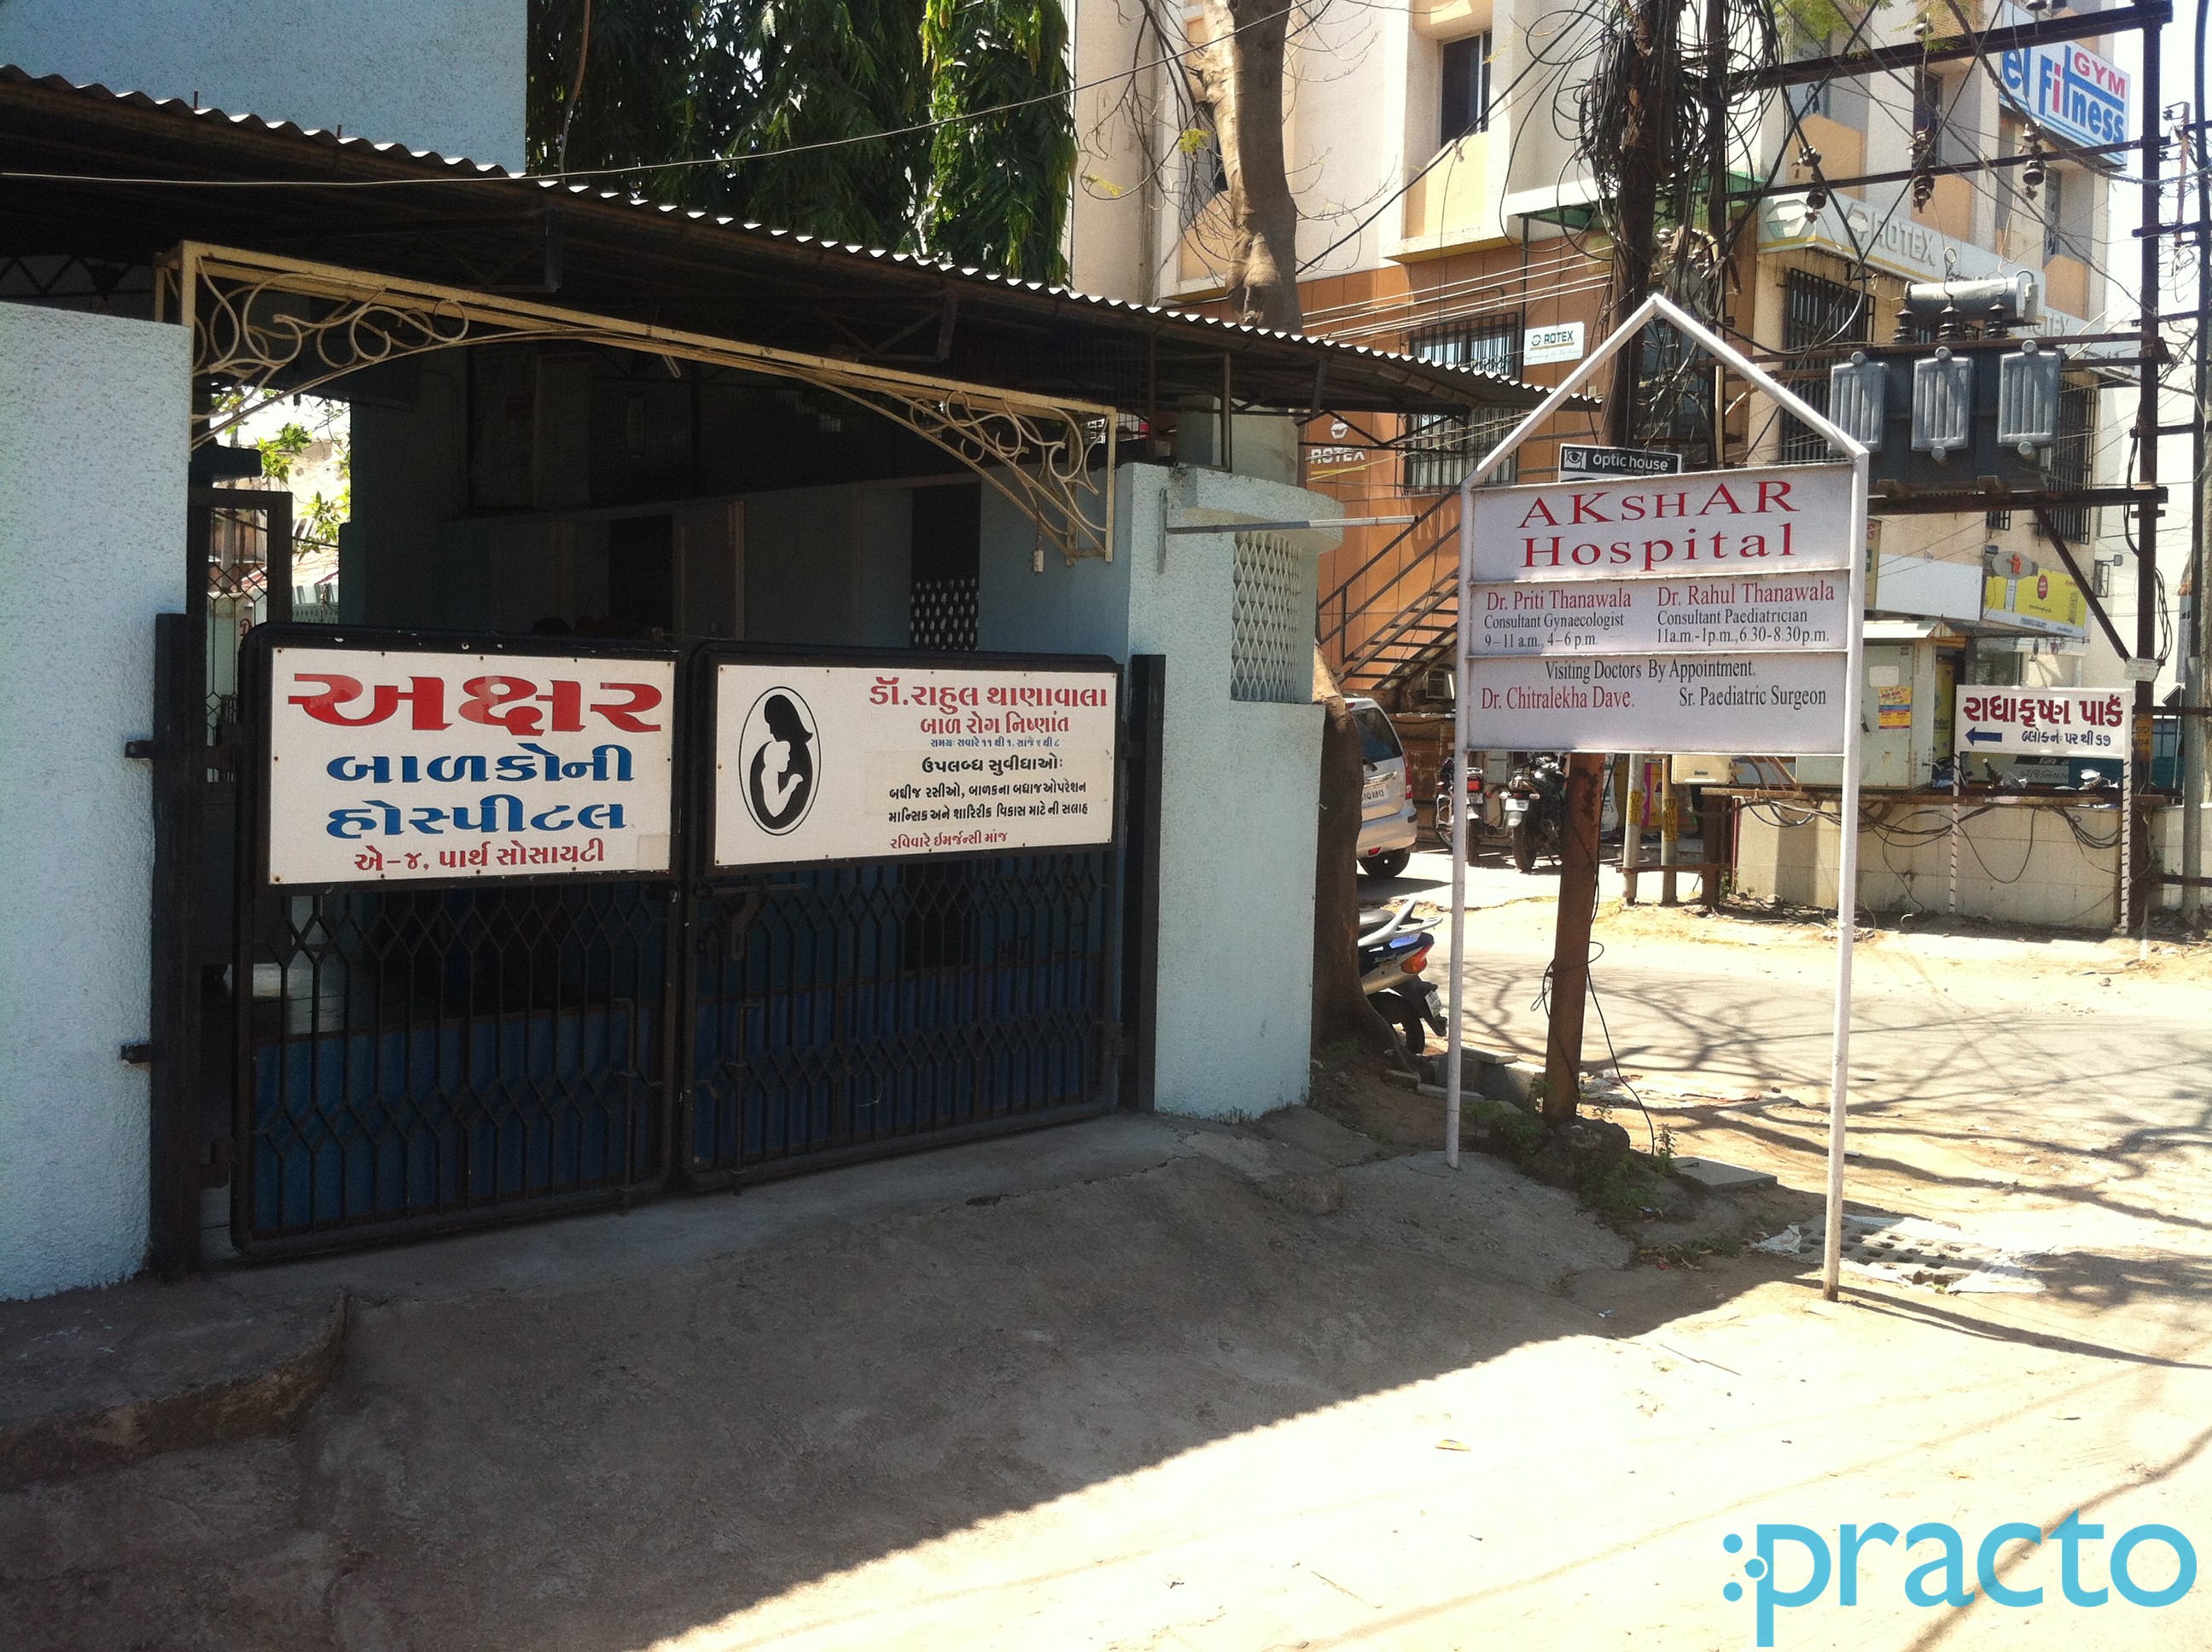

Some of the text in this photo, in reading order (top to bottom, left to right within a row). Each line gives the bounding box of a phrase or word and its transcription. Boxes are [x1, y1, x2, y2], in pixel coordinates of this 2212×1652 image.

[2074, 52, 2125, 99] GYM
[2039, 44, 2124, 143] Fitness
[1544, 330, 1574, 345] ROTEX
[1592, 452, 1626, 468] optic
[1629, 456, 1668, 470] house
[1516, 480, 1801, 529] AKSHAR
[1520, 522, 1796, 572] Hospital
[1487, 588, 1631, 610] Dr. Priti Thanawala
[1657, 579, 1835, 607] Dr. Rahul Thanawala
[1484, 611, 1624, 631] Consultant Gynaecologist
[1657, 607, 1807, 625] Consultant Paediatrician
[1545, 659, 1755, 683] Visiting Doctors By Appointment.
[288, 673, 663, 736] અક્ષર
[987, 687, 1108, 707] થાણાવાલા
[1481, 687, 1502, 709] Dr.
[1506, 685, 1587, 709] Chitralekha
[1679, 684, 1826, 711] Sr. Paediatric Surgeon
[920, 710, 1069, 734] બાળ રોગ નિષ્ણાંત
[1963, 695, 2071, 728] રાધાકૃષ્ણ
[958, 736, 980, 747] સવારે
[995, 736, 1004, 747] થી
[1043, 736, 1053, 747] થી
[2081, 730, 2093, 746] થી
[327, 743, 635, 782] બાળકોની
[922, 757, 984, 773] ઉપલબ્ધ
[969, 784, 1010, 797] બાળકના
[326, 794, 626, 839] હોસ્પીટલ
[930, 805, 950, 820] અને
[953, 803, 992, 819] શારિરીક
[997, 802, 1026, 817] વિકાસ
[1062, 803, 1088, 814] સલાહ
[439, 841, 492, 868] પાર્થ
[496, 837, 604, 866] સોસાયટી
[889, 832, 931, 849] રવિવારે
